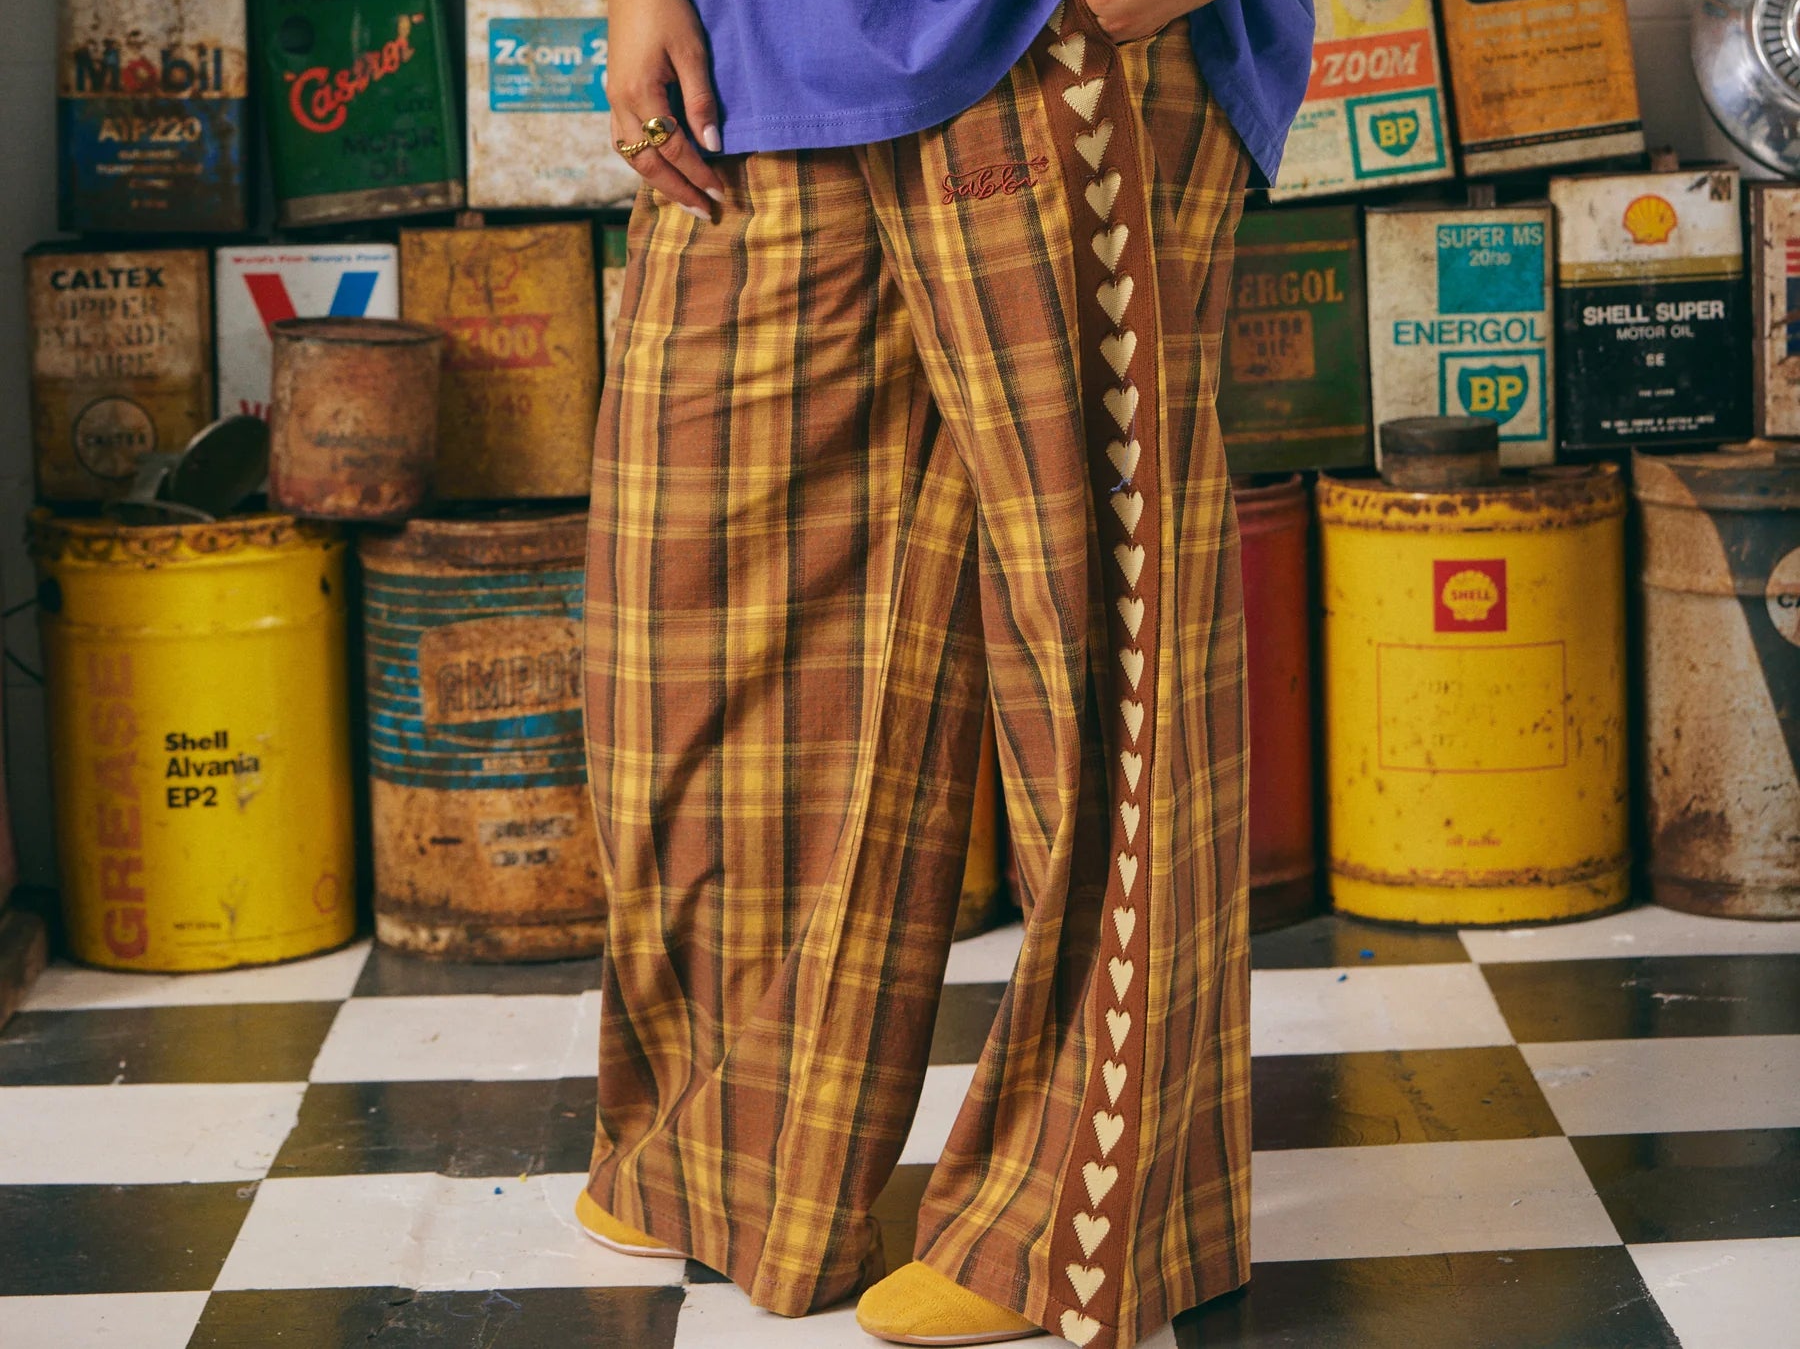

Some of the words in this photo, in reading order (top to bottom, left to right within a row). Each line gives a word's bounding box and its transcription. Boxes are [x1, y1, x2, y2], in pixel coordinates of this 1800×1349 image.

[495, 39, 582, 65] Zoom
[1321, 42, 1423, 87] ZOOM
[75, 45, 223, 93] Mobil
[1377, 116, 1417, 148] BP
[1439, 226, 1506, 249] SUPER
[1513, 225, 1544, 247] MS
[50, 266, 166, 291] CALTEX
[1582, 304, 1650, 327] SHELL
[1655, 300, 1726, 323] SUPER
[1393, 317, 1547, 346] ENERGOL
[1616, 325, 1666, 341] MOTOR
[1670, 324, 1695, 338] OIL
[1468, 374, 1524, 413] BP
[1450, 588, 1491, 601] SHELL
[165, 730, 228, 751] Shell
[165, 753, 260, 779] Alvania
[88, 651, 149, 961] GREASE
[167, 786, 218, 809] EP2
